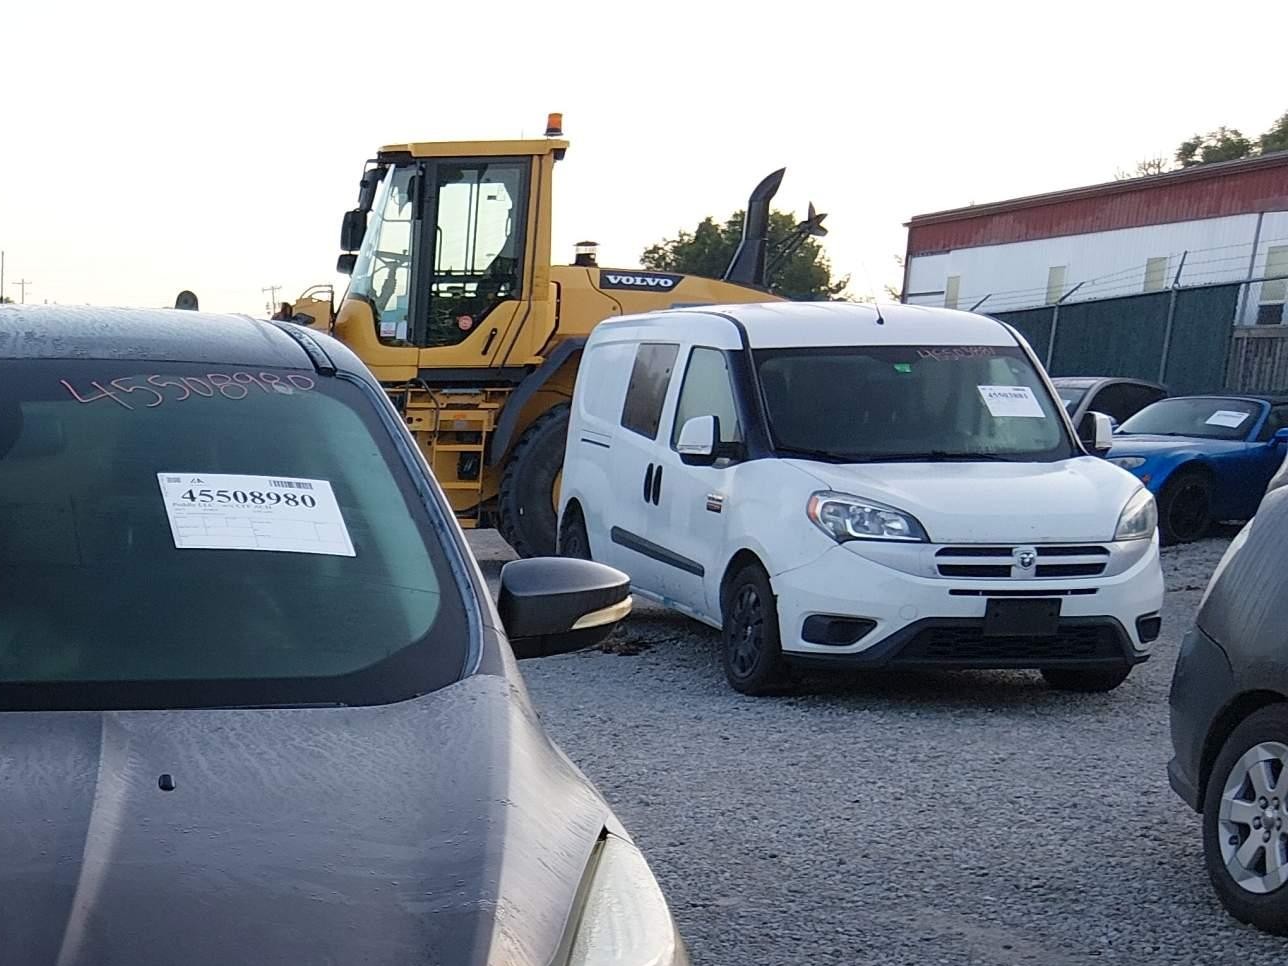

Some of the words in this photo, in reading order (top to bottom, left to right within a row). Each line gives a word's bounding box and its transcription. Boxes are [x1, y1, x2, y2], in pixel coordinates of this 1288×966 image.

[606, 275, 674, 287] VOLVO
[60, 371, 315, 410] 45508980
[181, 488, 317, 509] 45508980
